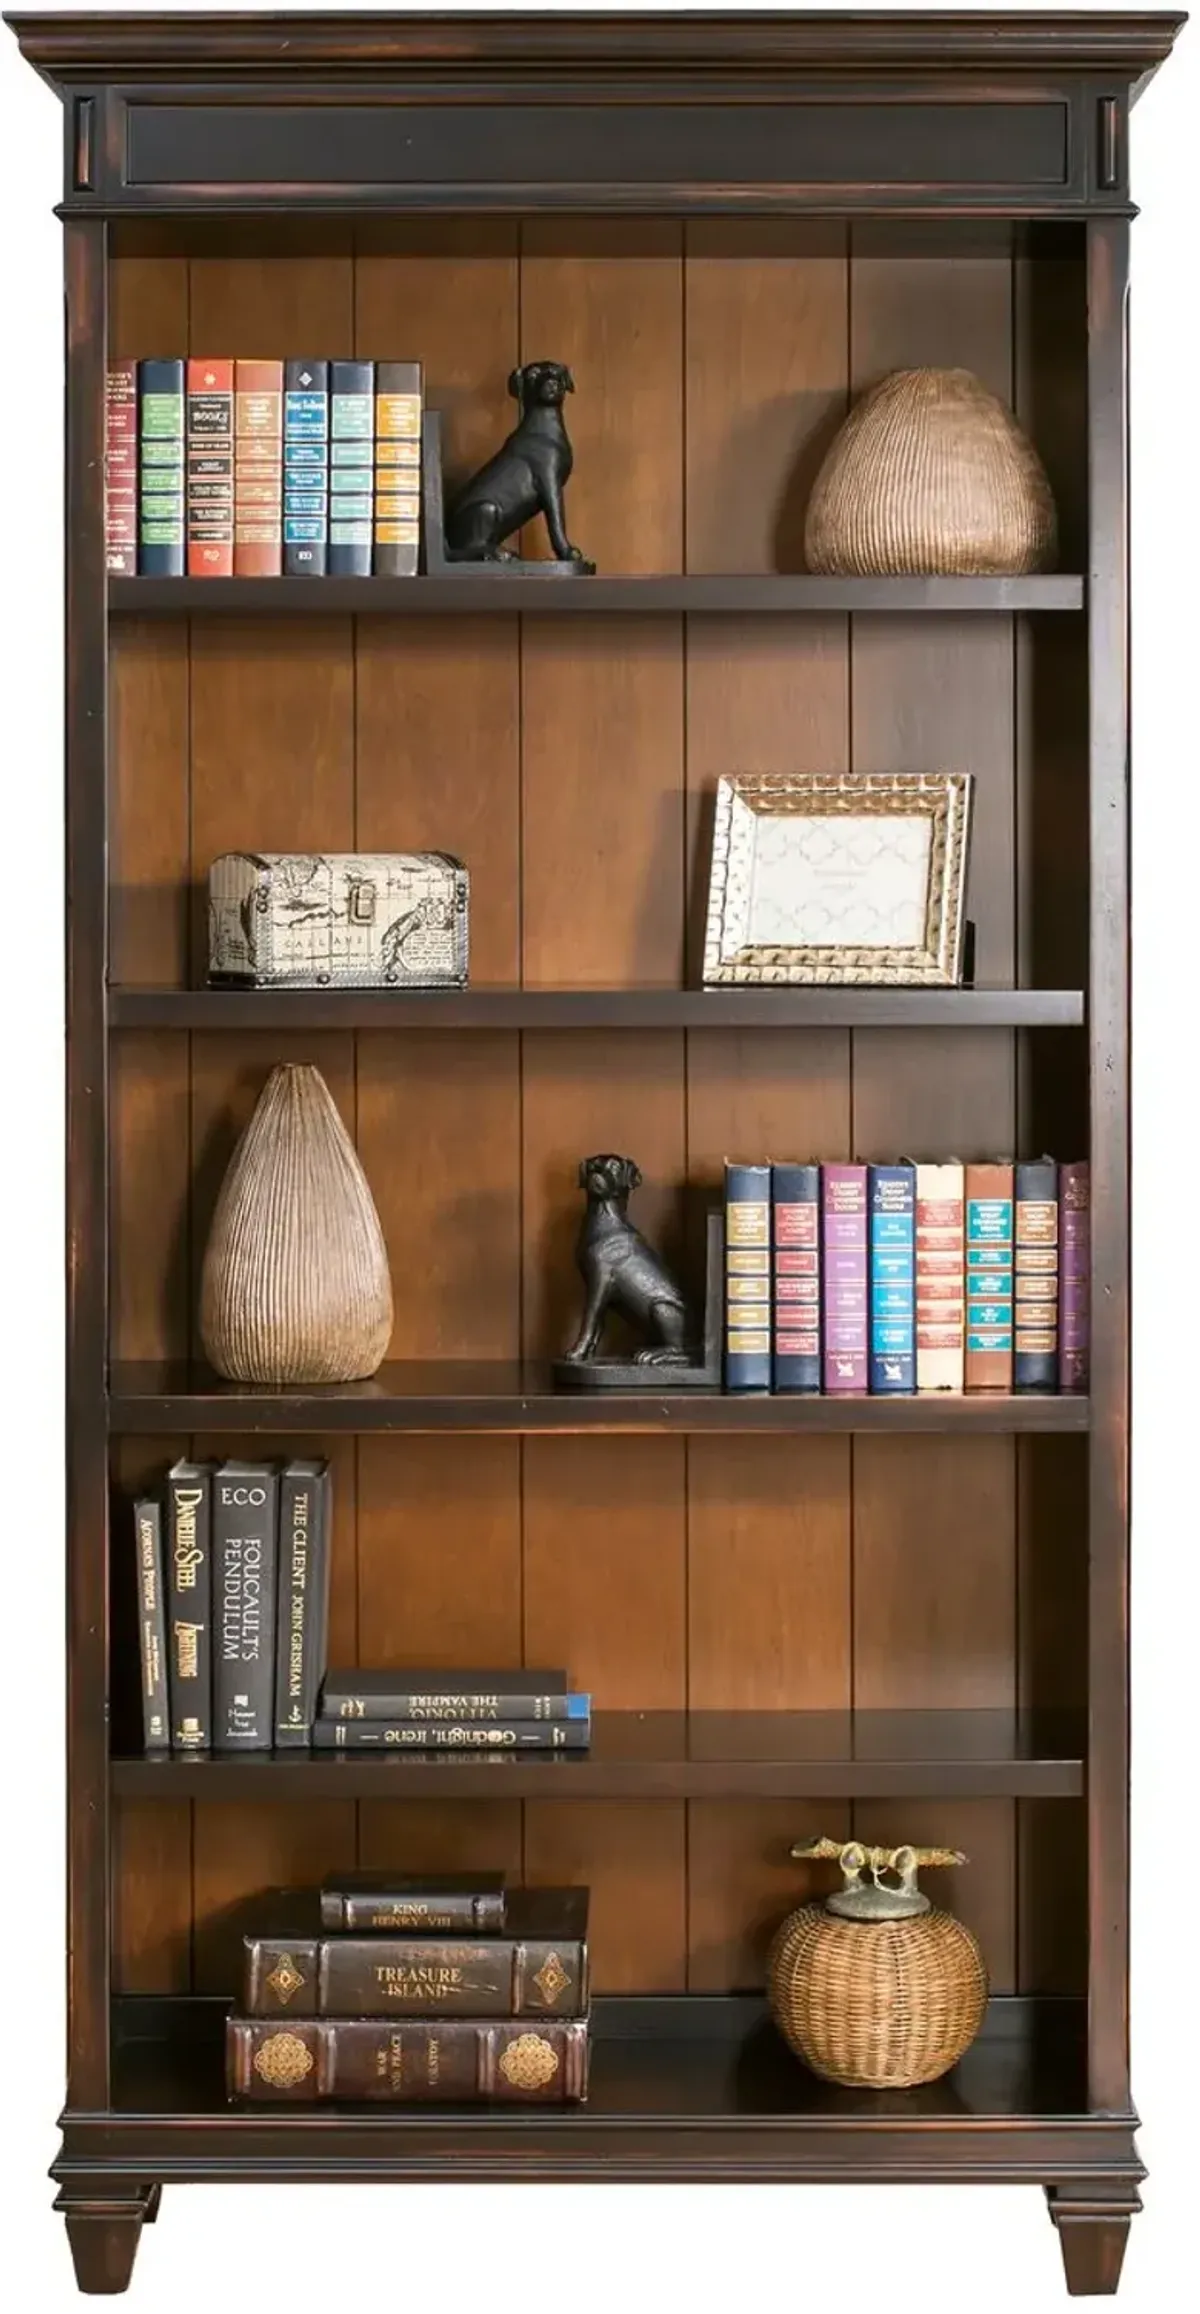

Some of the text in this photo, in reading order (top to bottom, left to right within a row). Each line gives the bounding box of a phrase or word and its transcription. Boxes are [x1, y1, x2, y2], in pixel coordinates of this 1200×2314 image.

[221, 1487, 266, 1506] ECO
[174, 1488, 204, 1593] DANIELLE STEEL
[223, 1538, 242, 1660] PENDULUM
[242, 1538, 261, 1661] FOUCAULT'S
[289, 1493, 308, 1697] THE CLIENT JOHN GRISHAM
[408, 1695, 499, 1707] THE VAMPIRE
[384, 1727, 517, 1745] Goodnight, Irene
[393, 1904, 428, 1915] KING
[372, 1915, 451, 1927] HENRY VIII
[376, 1966, 461, 1983] TREASURE
[387, 1983, 447, 1999] ISLAND
